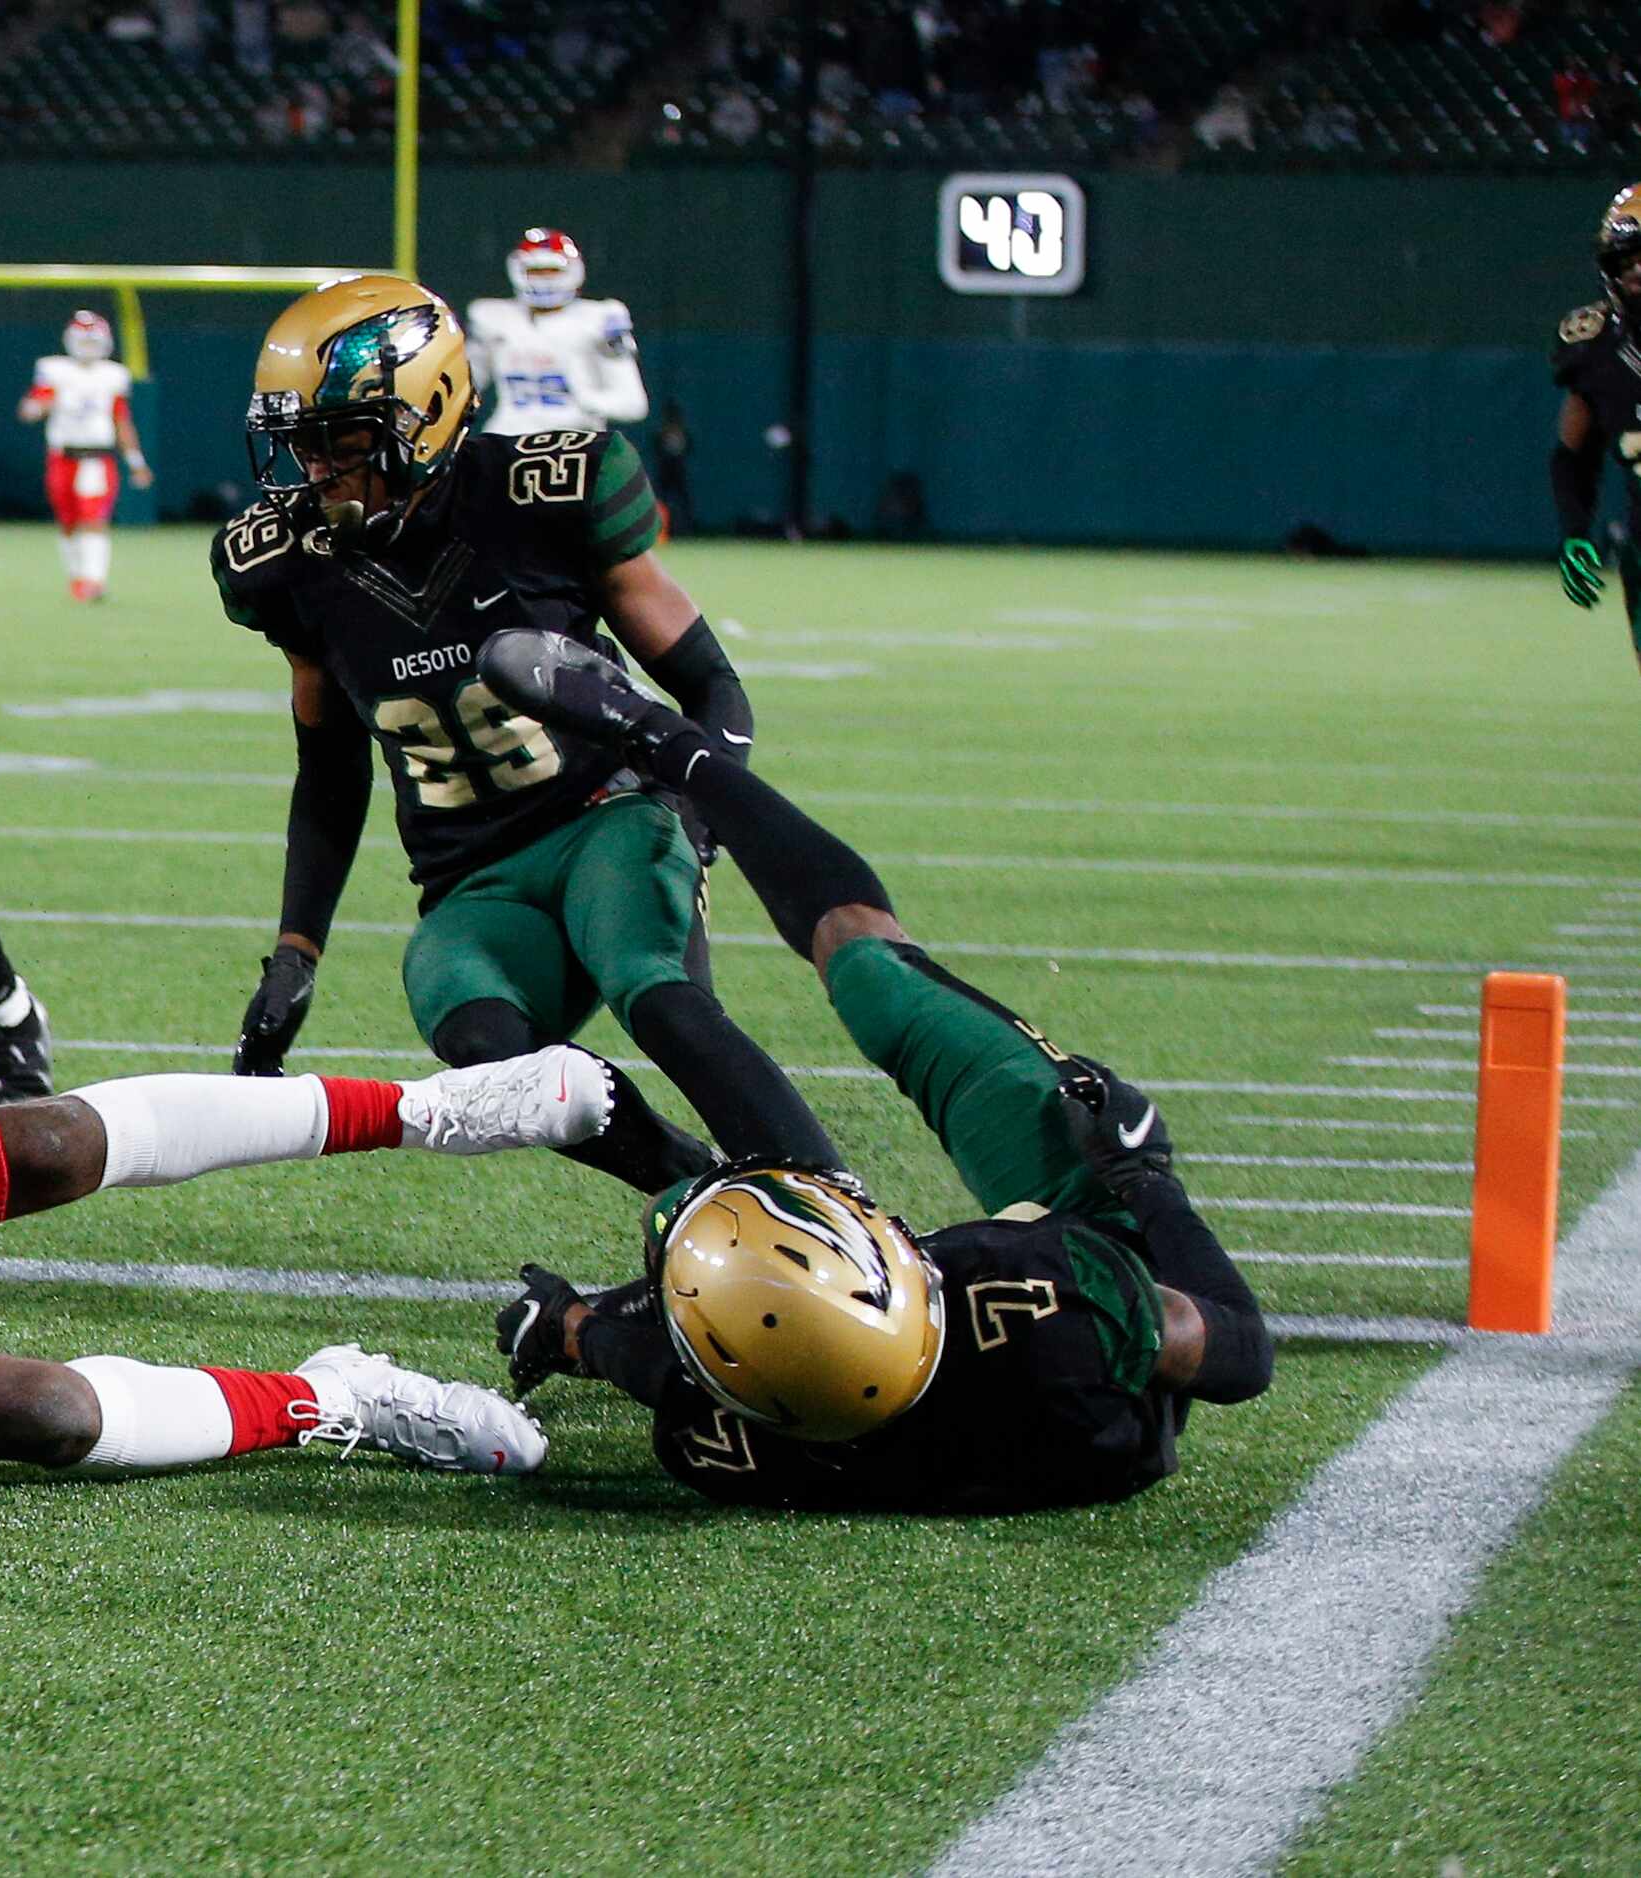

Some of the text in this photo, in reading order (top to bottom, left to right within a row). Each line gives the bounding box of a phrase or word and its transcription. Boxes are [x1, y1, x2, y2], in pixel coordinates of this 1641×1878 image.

[509, 429, 597, 506] 29
[392, 643, 471, 681] DESOTO
[374, 672, 562, 808] 29
[966, 1278, 1060, 1352] 7
[672, 1407, 757, 1472] 7
